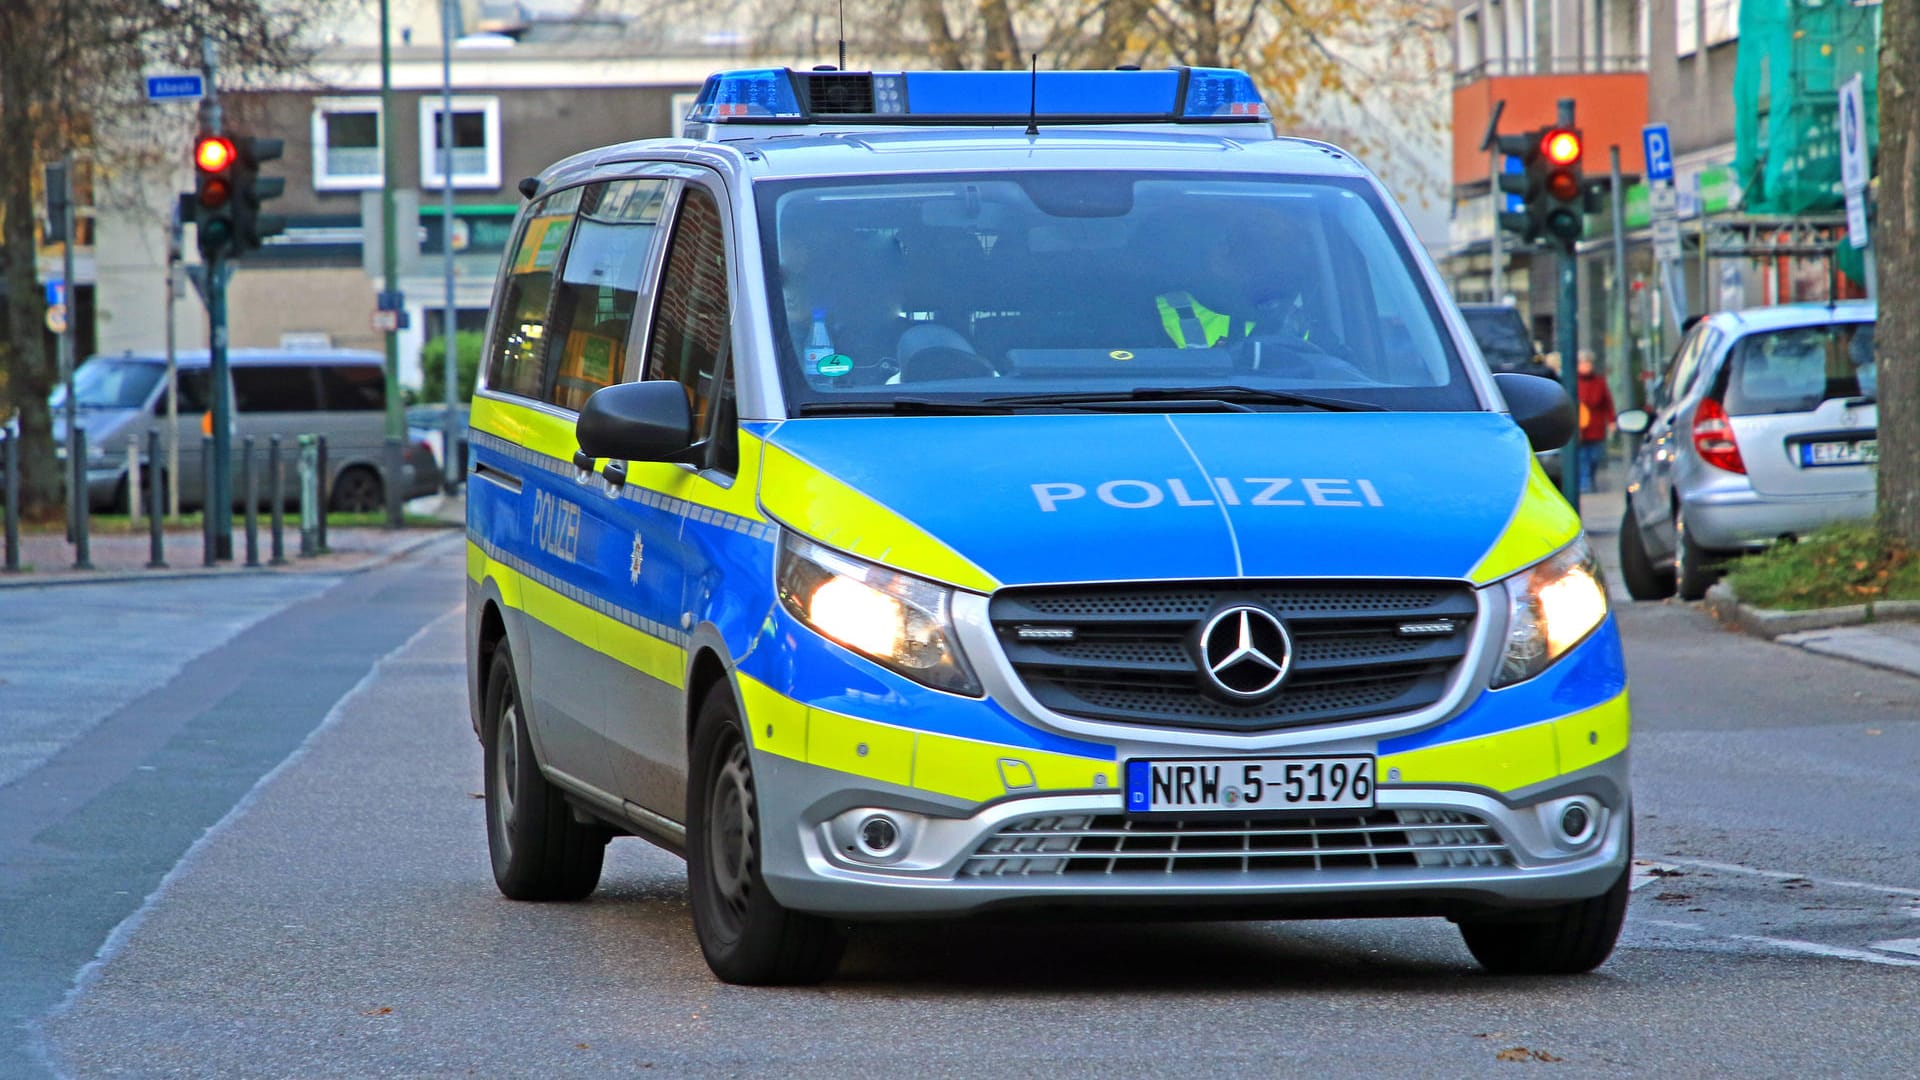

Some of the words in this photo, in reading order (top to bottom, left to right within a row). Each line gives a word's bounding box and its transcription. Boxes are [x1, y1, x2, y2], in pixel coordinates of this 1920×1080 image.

[830, 355, 841, 366] 4
[1030, 477, 1384, 512] POLIZEI
[531, 488, 581, 564] POLIZEI
[1133, 792, 1144, 803] D
[1152, 765, 1220, 804] NRW
[1243, 762, 1370, 803] 5-5196
